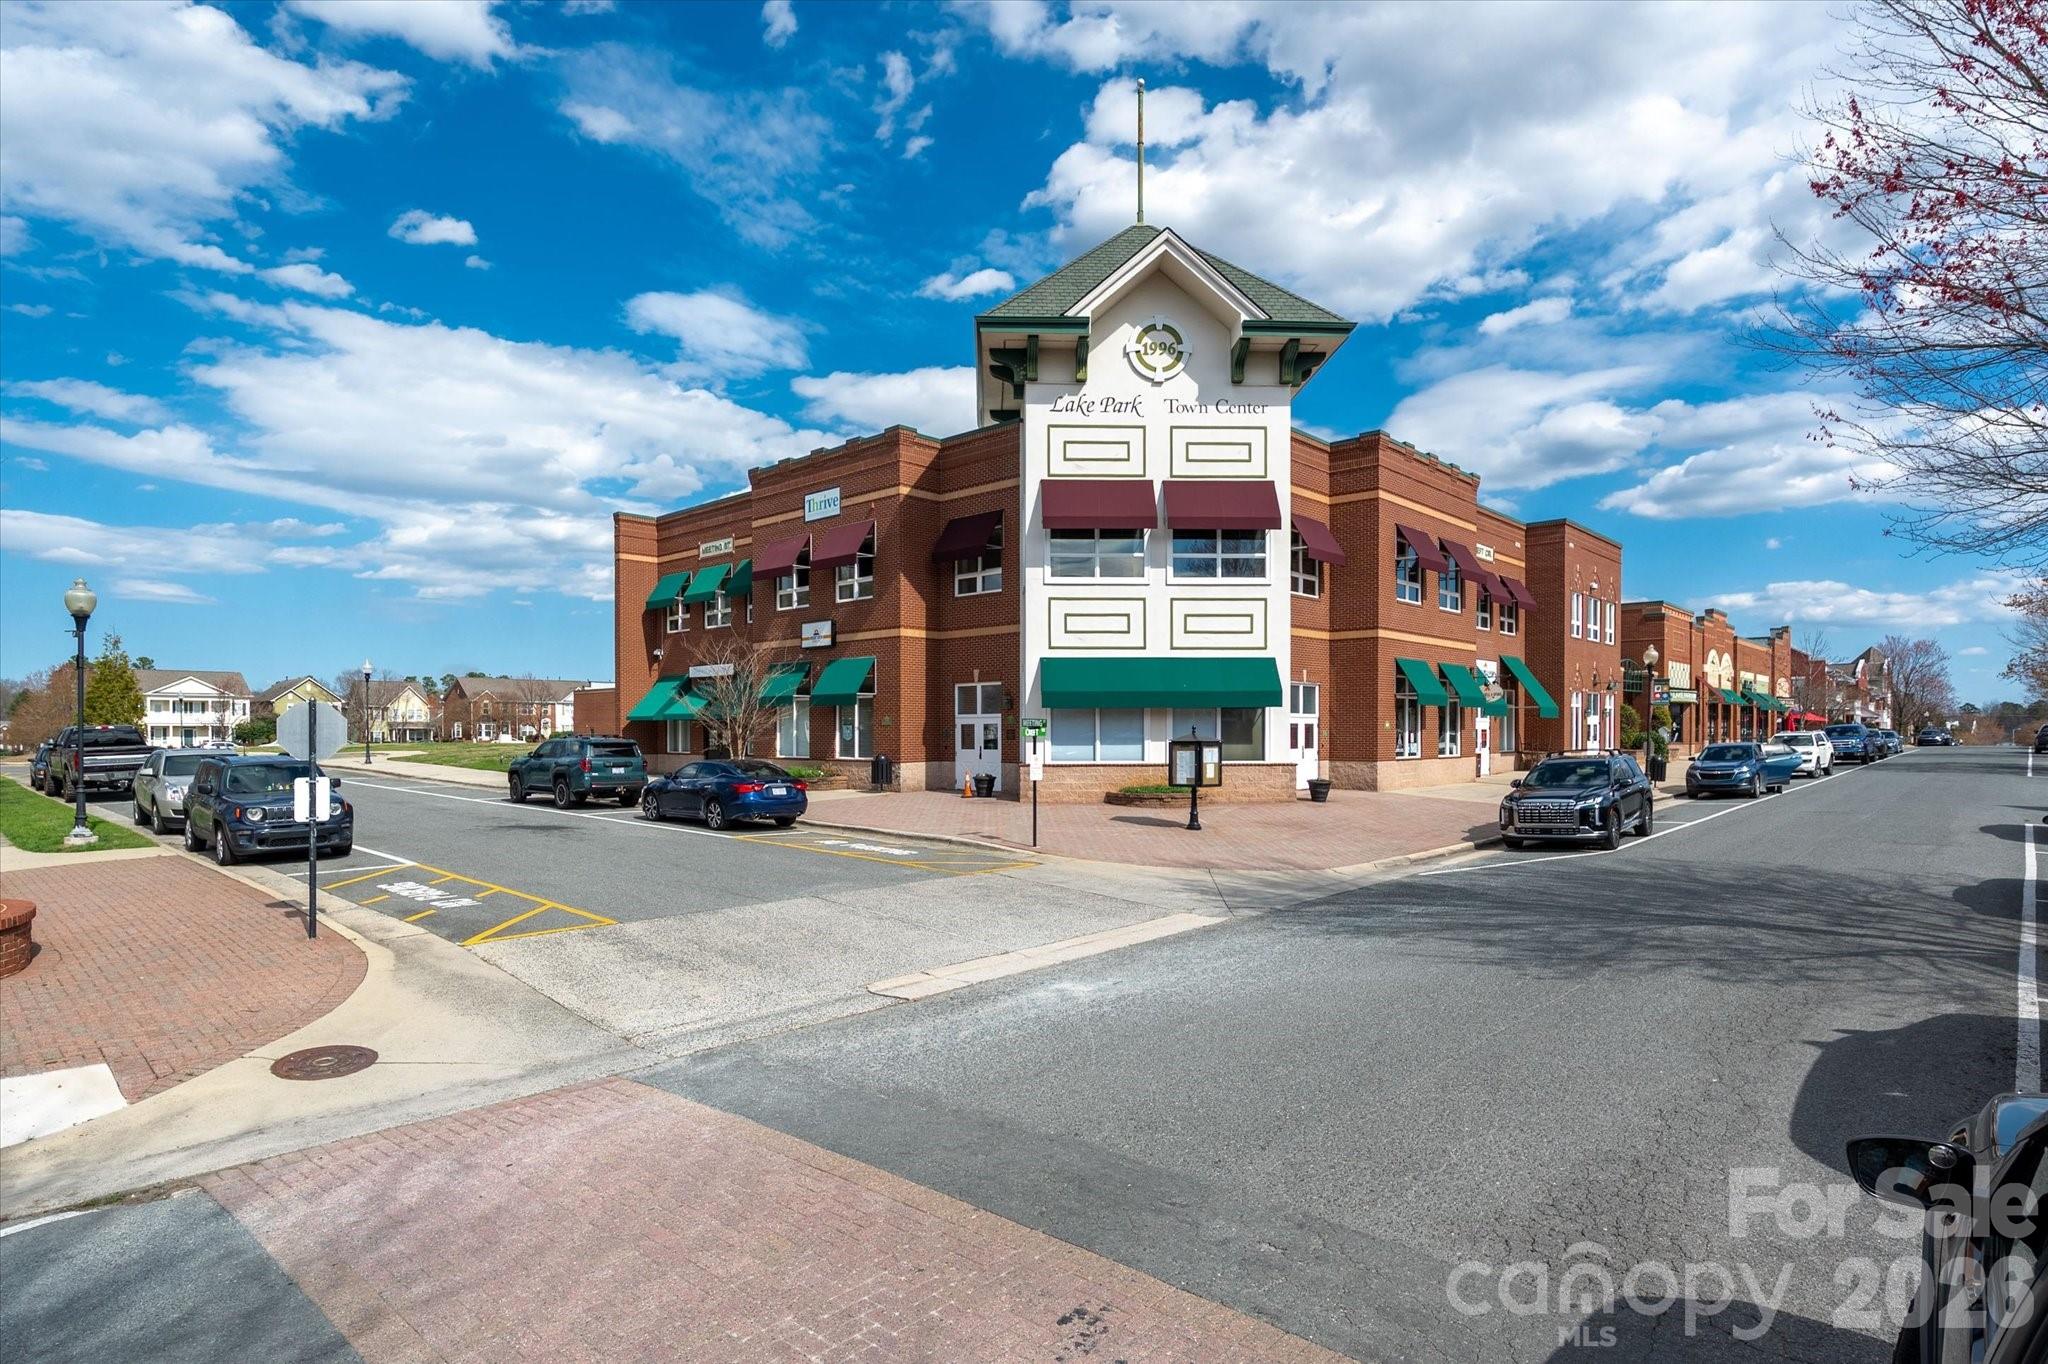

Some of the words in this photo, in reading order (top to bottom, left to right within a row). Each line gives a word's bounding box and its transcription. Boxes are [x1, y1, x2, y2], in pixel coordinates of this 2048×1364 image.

[1142, 341, 1176, 356] 1996
[1050, 393, 1096, 417] Lake
[1100, 394, 1144, 418] Park
[1164, 398, 1208, 414] Town
[1215, 398, 1269, 415] Center
[806, 495, 839, 513] Thrive
[702, 542, 723, 555] MEETING
